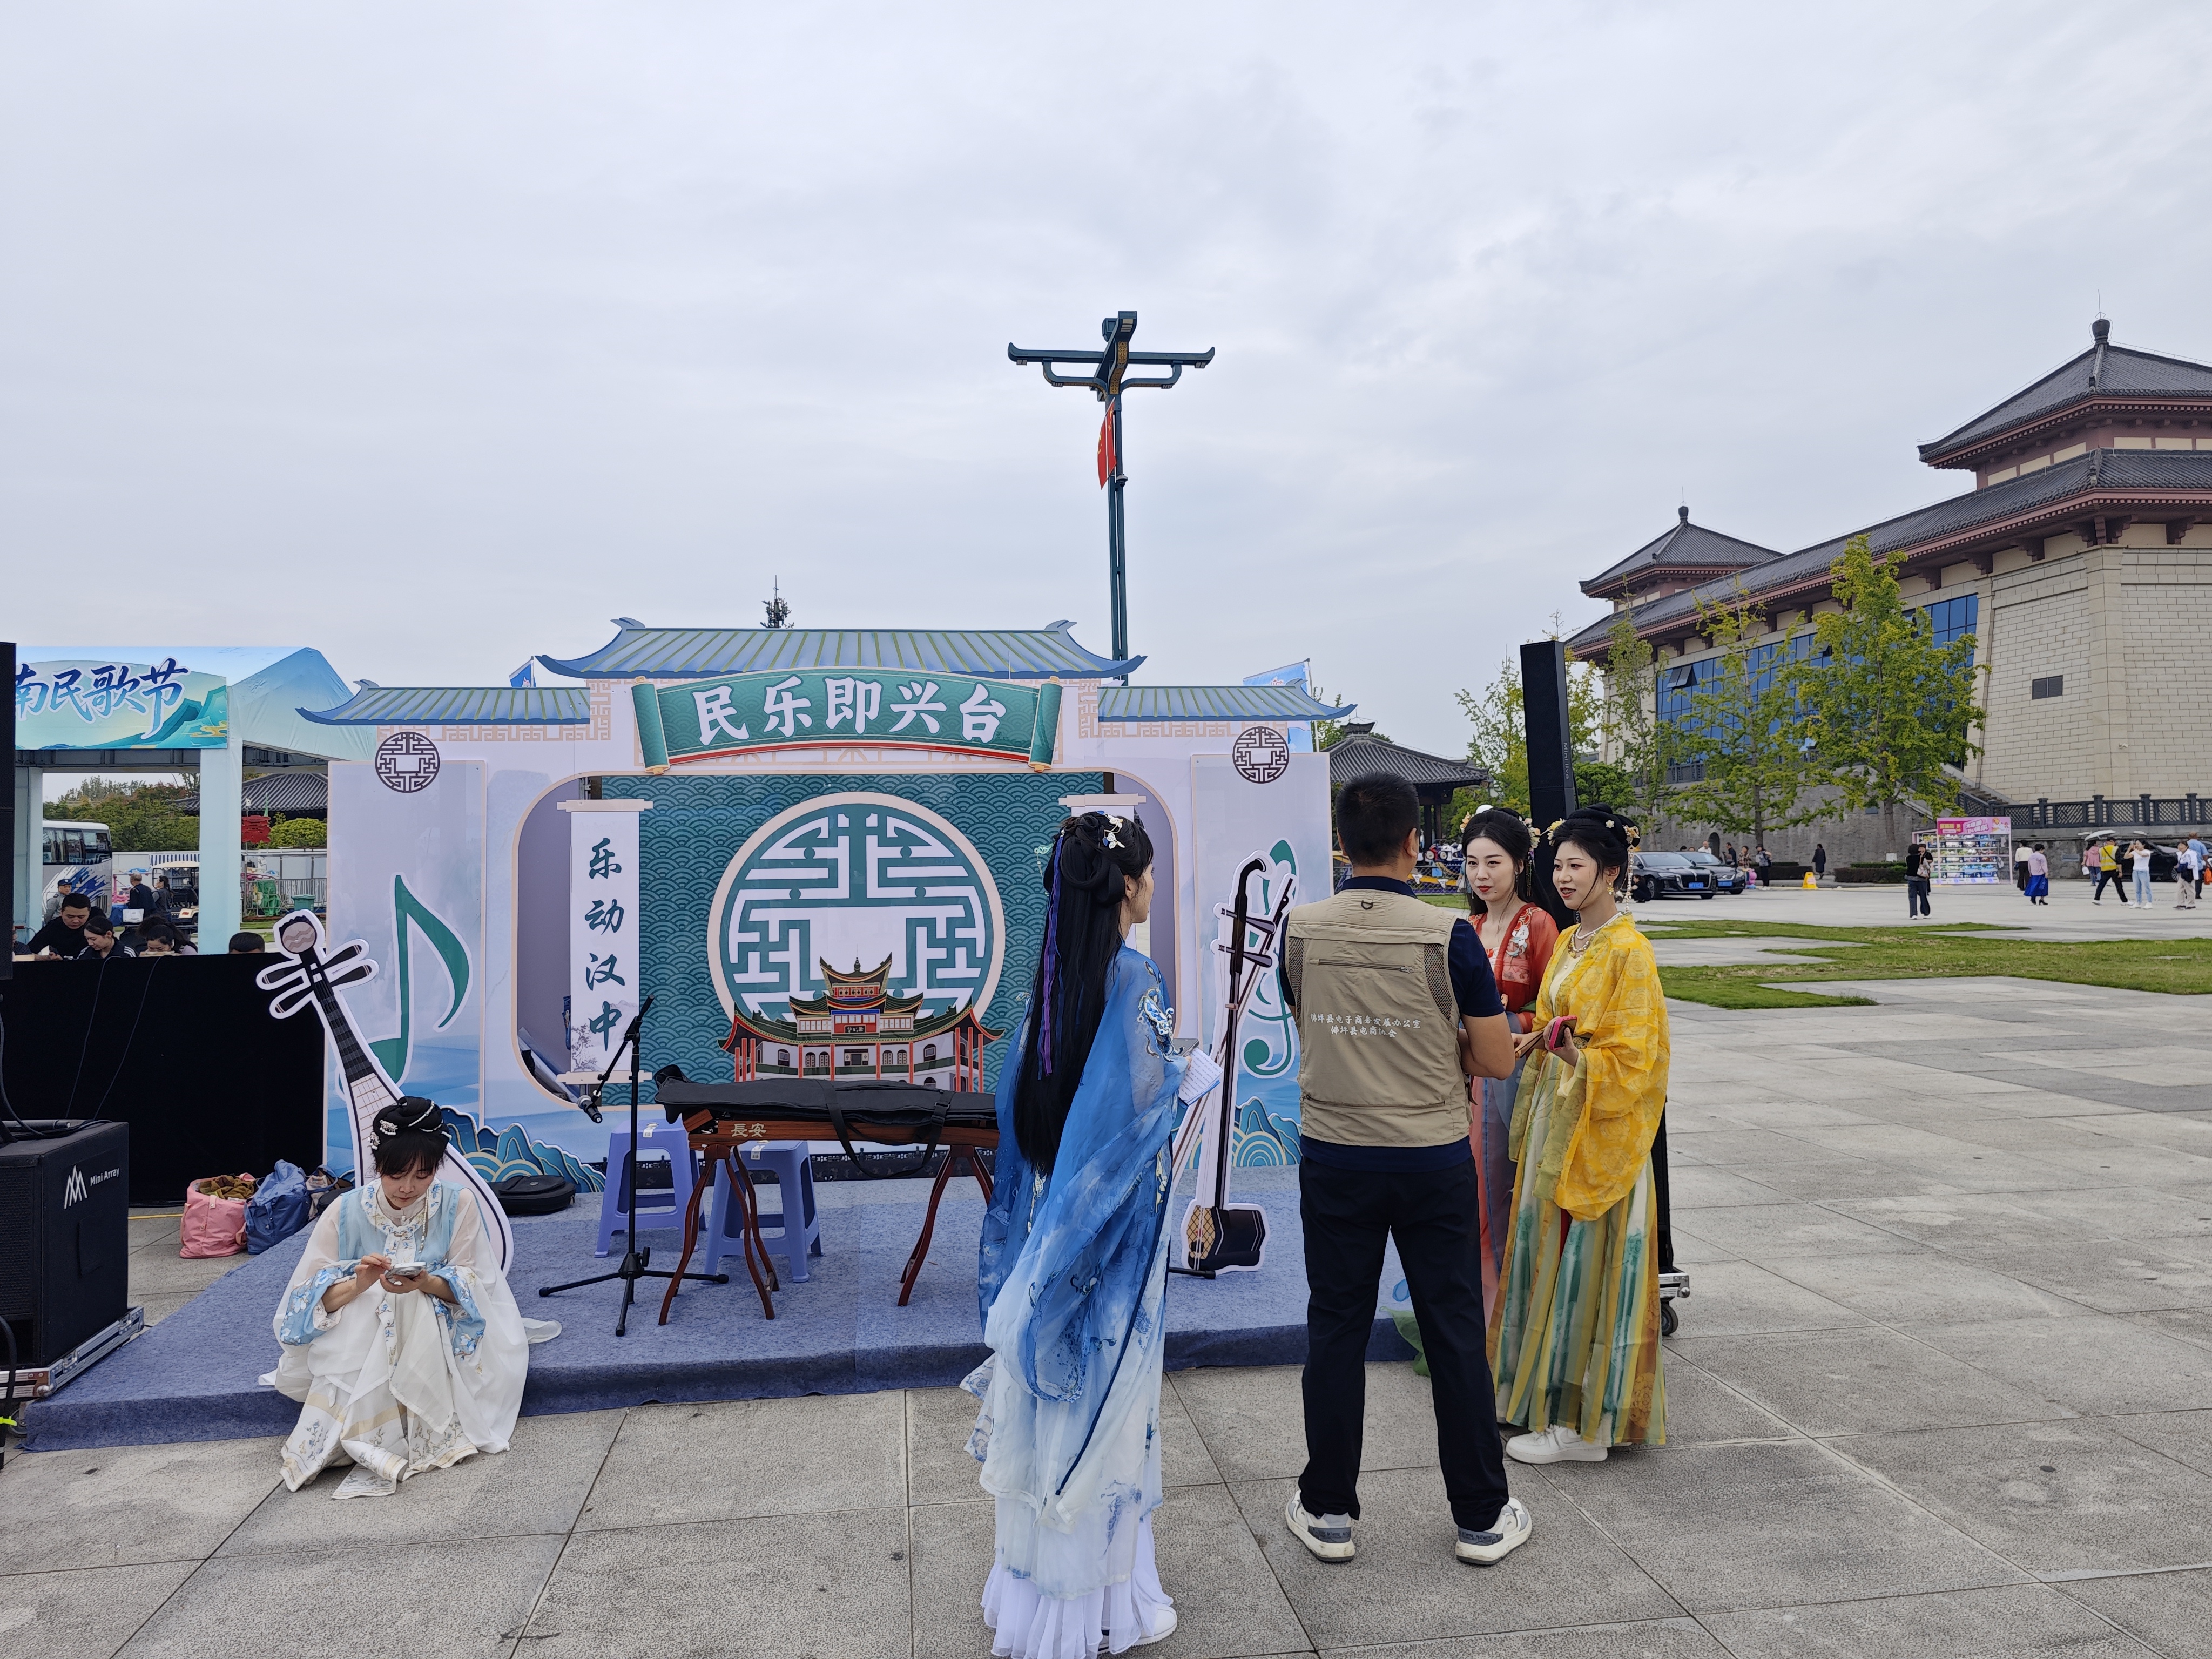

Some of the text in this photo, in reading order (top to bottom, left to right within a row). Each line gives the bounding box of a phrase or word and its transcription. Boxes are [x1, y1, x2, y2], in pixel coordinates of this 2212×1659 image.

[693, 675, 1006, 745] 民乐即兴台
[584, 838, 625, 1052] 乐动汉中
[1310, 1013, 1421, 1029] 佛坪县电子商务发展办公室
[731, 1122, 767, 1138] 長安
[90, 1168, 120, 1186] Mini Array
